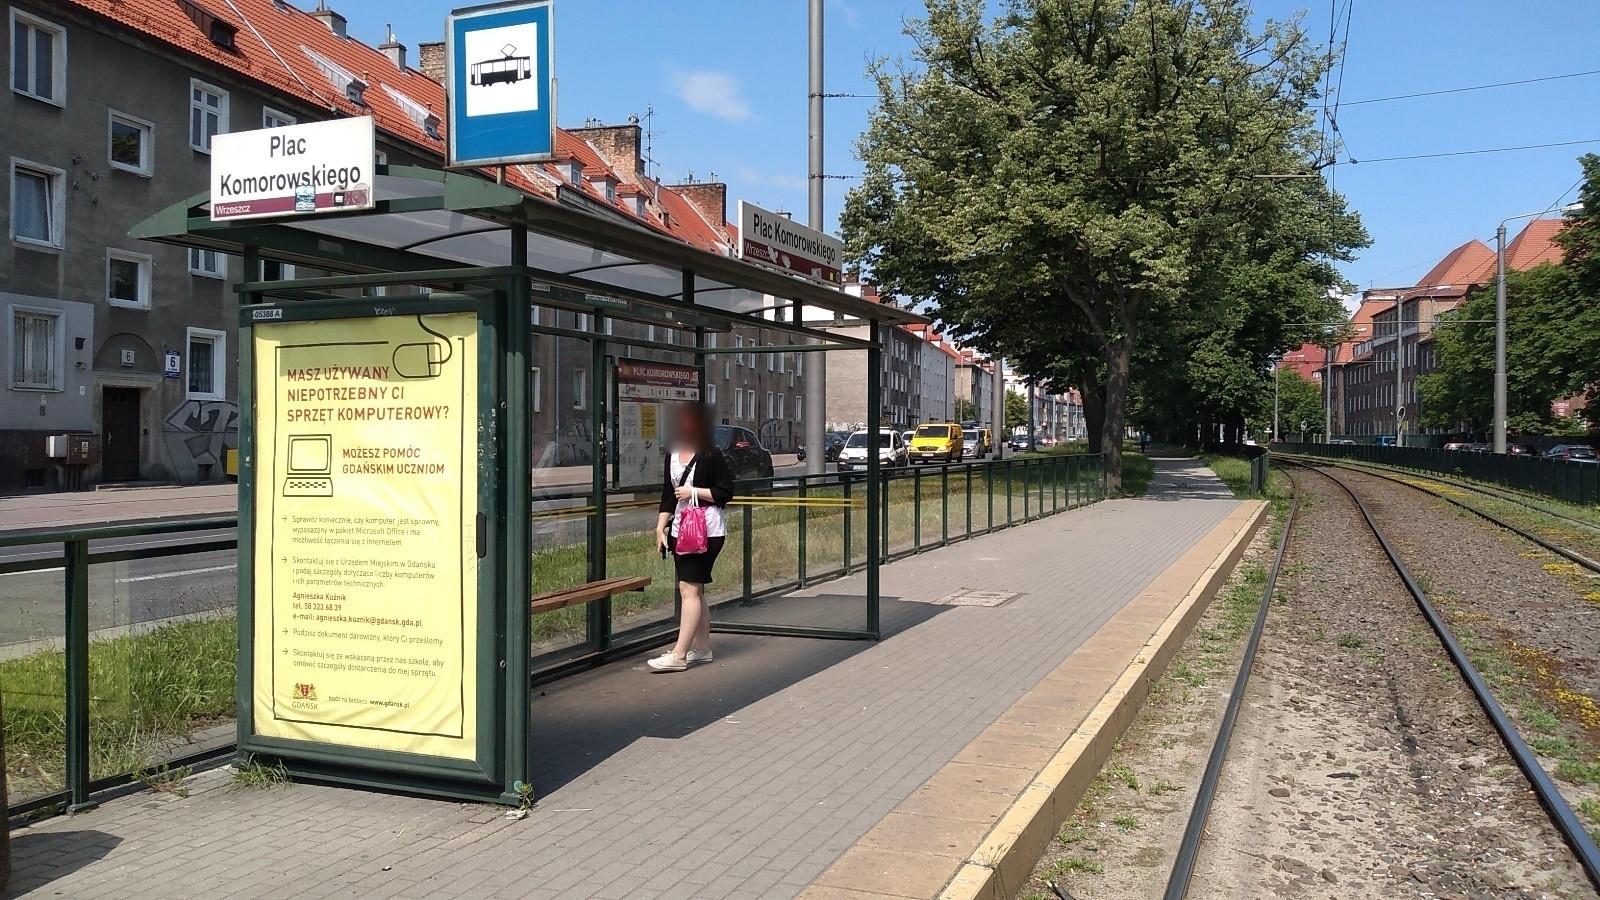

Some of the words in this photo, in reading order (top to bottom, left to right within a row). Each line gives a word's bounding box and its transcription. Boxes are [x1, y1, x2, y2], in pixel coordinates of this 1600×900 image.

[270, 134, 307, 158] Plac
[220, 164, 361, 197] Komorowskiego
[215, 204, 251, 216] Wrzeszcz
[753, 213, 773, 239] Plac
[775, 221, 836, 264] Komorowskiego
[274, 310, 280, 318] A
[170, 356, 176, 368] 6
[287, 368, 321, 382] MASZ
[324, 363, 390, 381] UŻYWANY
[287, 386, 388, 402] NIEPOTRZEBNY
[391, 386, 405, 400] CI
[287, 408, 334, 425] SPRZĘT
[337, 406, 450, 421] KOMPUTEROWY?
[342, 445, 381, 459] MOŻESZ
[383, 445, 421, 459] POMÓC
[342, 461, 395, 475] GDAŃSKIM
[396, 463, 445, 475] UCZNIOM
[292, 592, 324, 601] Agnieszka
[304, 602, 312, 610] 58
[292, 613, 315, 621] e-mail:
